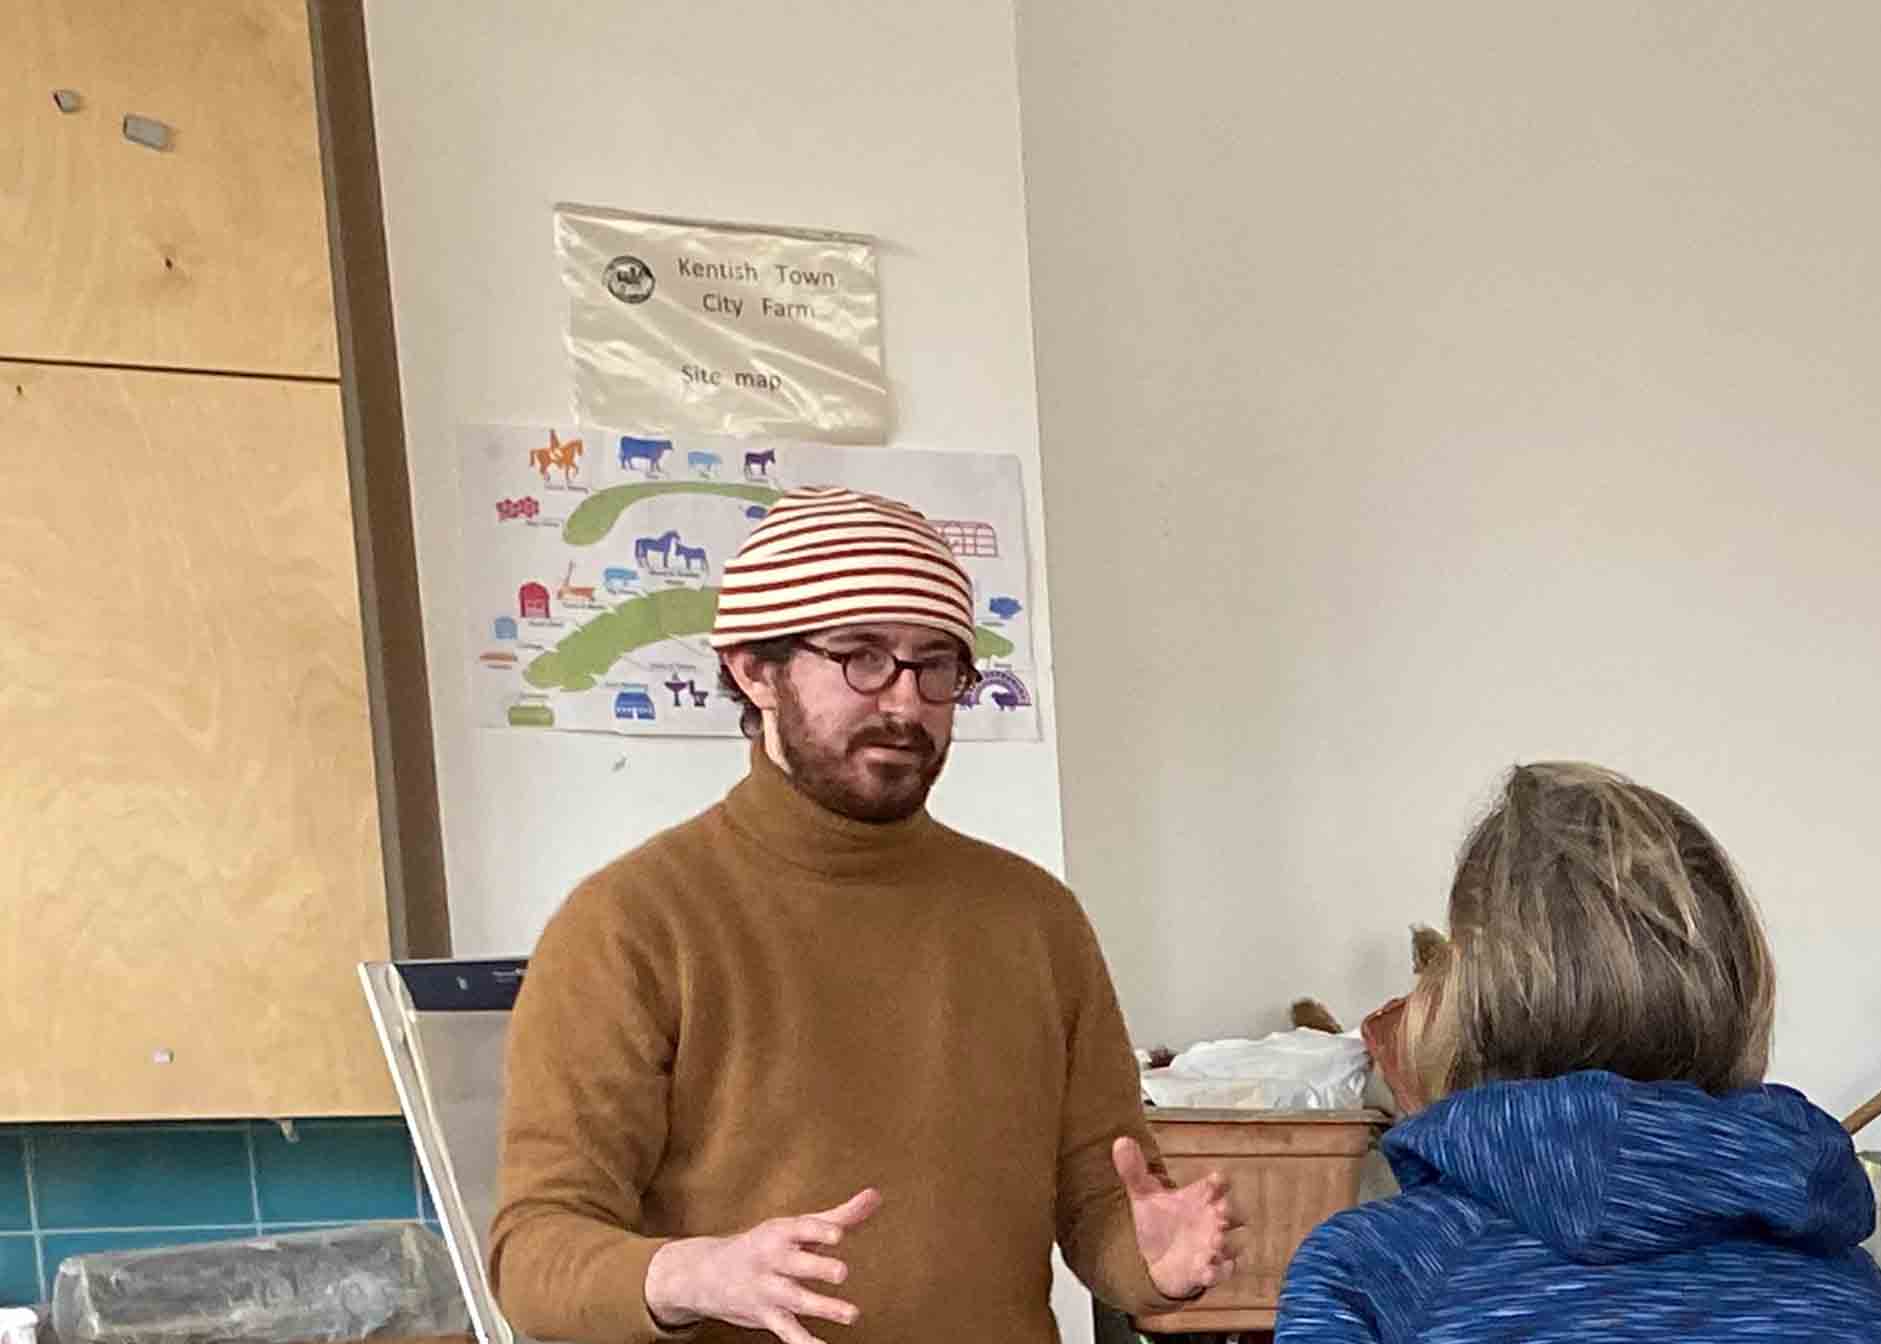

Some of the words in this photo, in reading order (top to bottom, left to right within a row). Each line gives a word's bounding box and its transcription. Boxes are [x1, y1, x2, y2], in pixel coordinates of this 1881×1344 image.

[677, 257, 759, 281] Kentish
[774, 264, 836, 287] Town
[702, 293, 744, 319] City
[761, 297, 816, 319] Farm
[680, 364, 721, 386] Site
[734, 371, 782, 392] map
